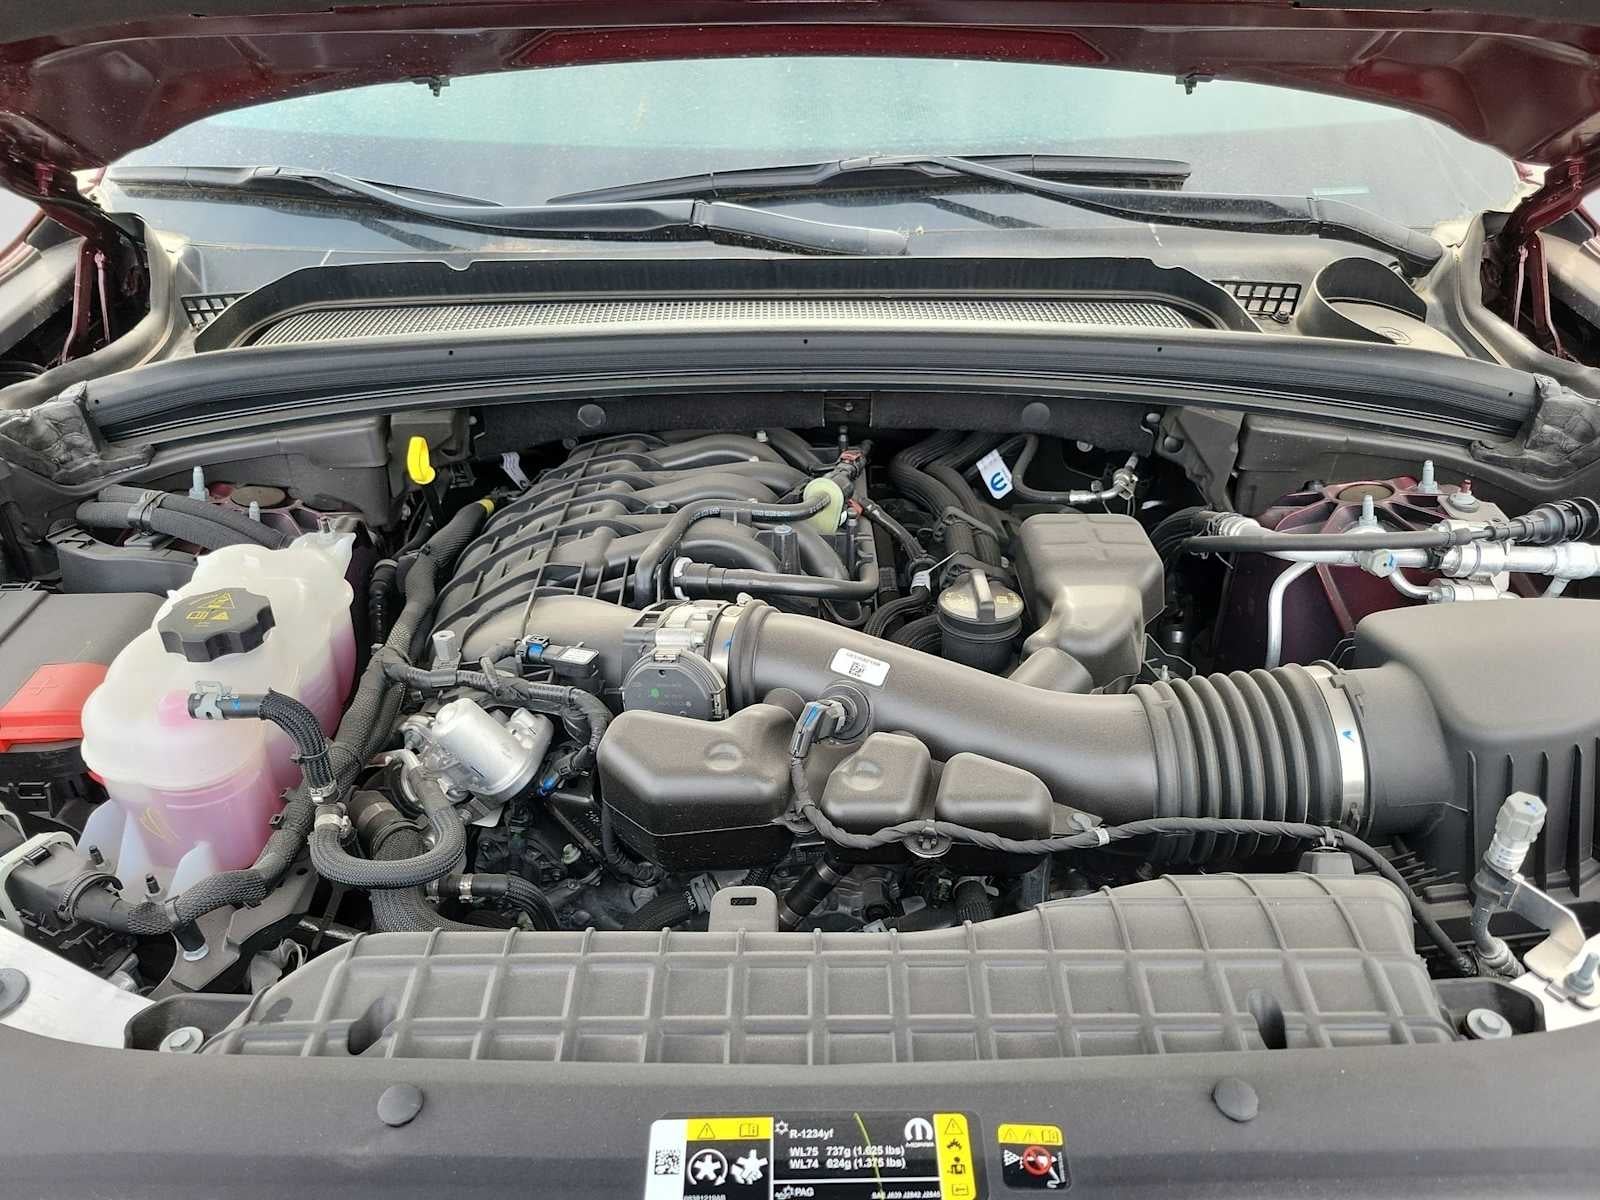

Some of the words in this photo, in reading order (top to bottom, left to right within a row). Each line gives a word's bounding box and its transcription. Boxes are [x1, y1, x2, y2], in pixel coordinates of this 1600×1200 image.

[789, 1128, 834, 1140] R-1234yf
[789, 1146, 819, 1157] WL75
[825, 1146, 852, 1158] 737g
[885, 1144, 905, 1157] lbs)
[789, 1158, 819, 1169] WL74
[825, 1158, 852, 1170] 624g
[885, 1157, 907, 1169] lbs)
[794, 1186, 815, 1197] PAG
